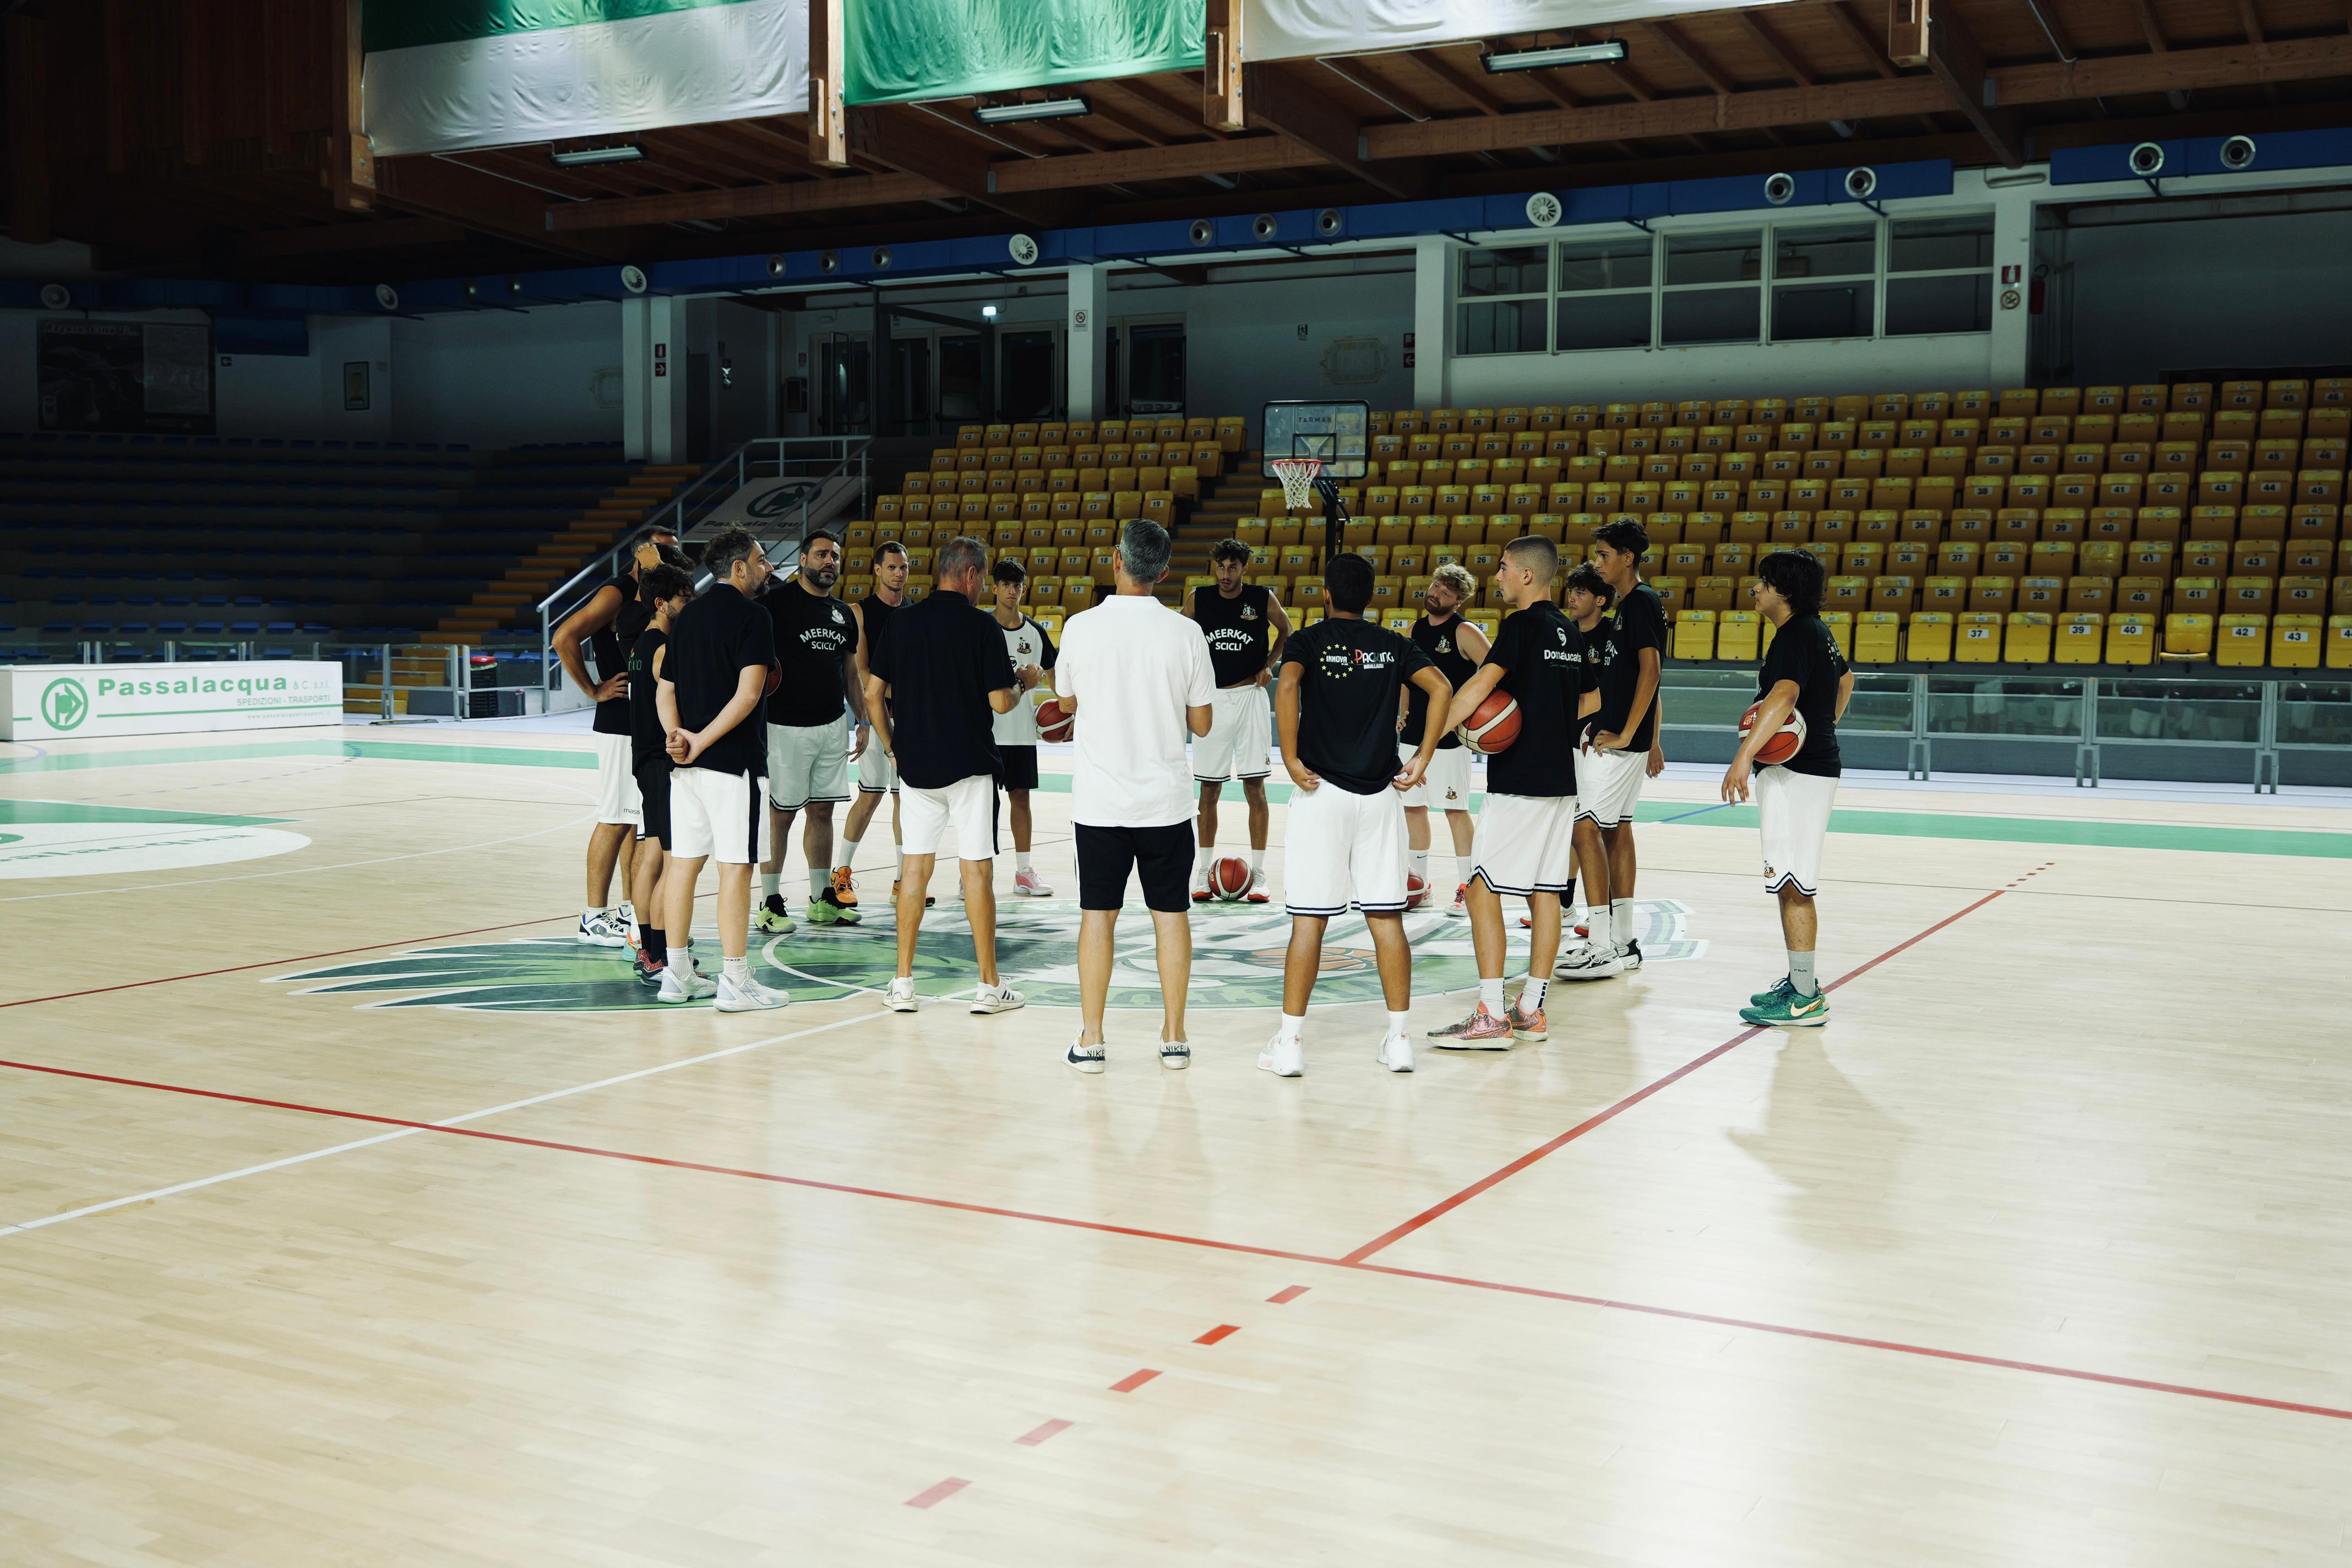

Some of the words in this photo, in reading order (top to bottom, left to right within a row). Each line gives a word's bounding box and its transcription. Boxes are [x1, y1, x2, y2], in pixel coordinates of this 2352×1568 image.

[799, 628, 847, 645] MEERKAT
[1205, 628, 1254, 645] MEERKAT
[811, 641, 836, 651] SCICLI
[1215, 642, 1242, 651] SCICLI
[98, 676, 287, 696] Passalacqua
[293, 681, 299, 689] &
[237, 698, 281, 706] SPEDIZIONI
[288, 695, 330, 704] TRASPORTI
[1087, 1049, 1104, 1057] NIKE
